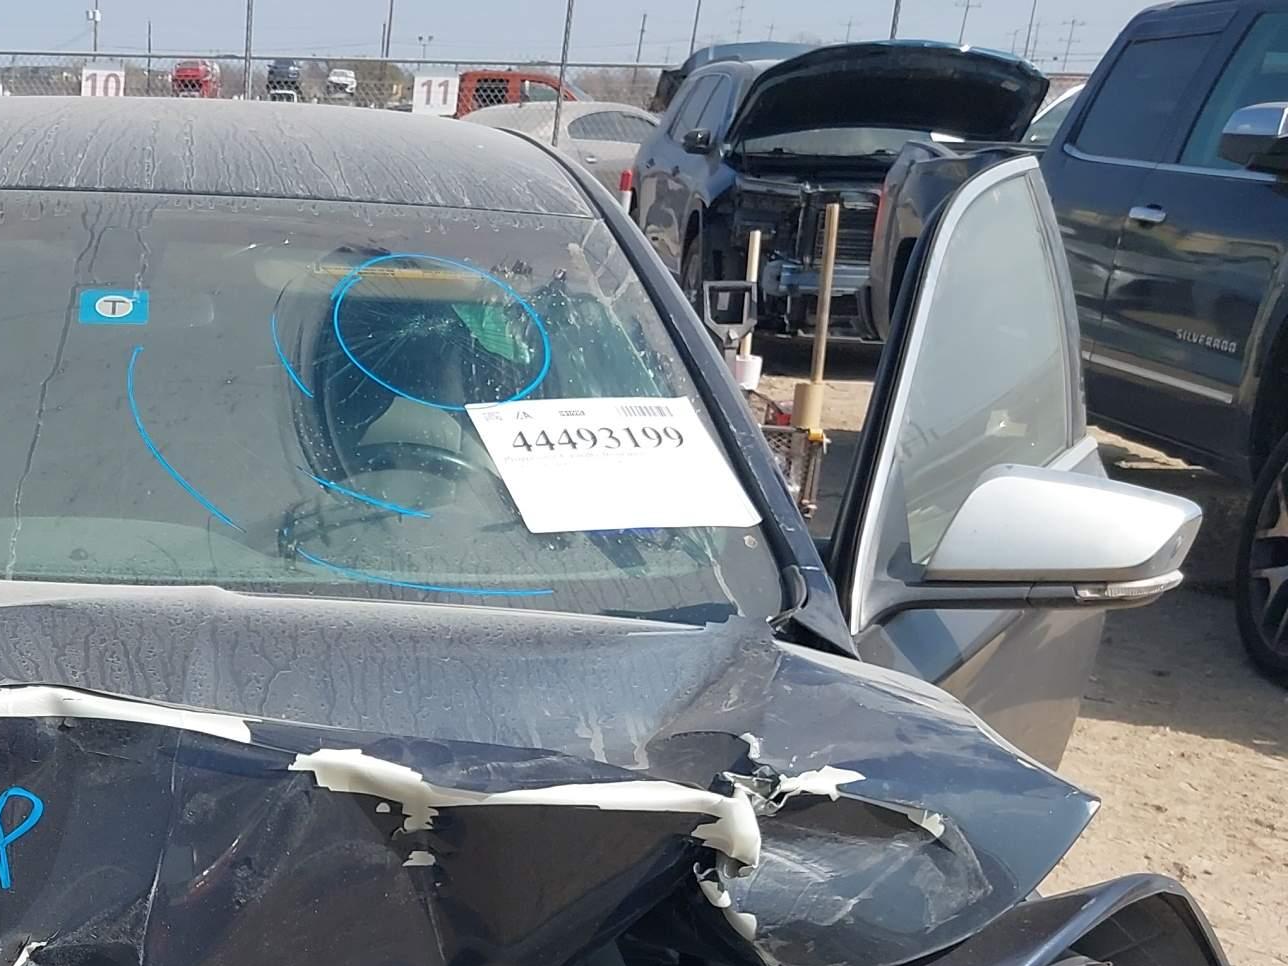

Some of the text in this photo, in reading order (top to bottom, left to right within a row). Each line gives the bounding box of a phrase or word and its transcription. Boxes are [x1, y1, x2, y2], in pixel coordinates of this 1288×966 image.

[85, 72, 122, 97] 10
[421, 79, 449, 106] 11
[1176, 328, 1237, 353] SILVERADO
[512, 426, 684, 452] 44493199
